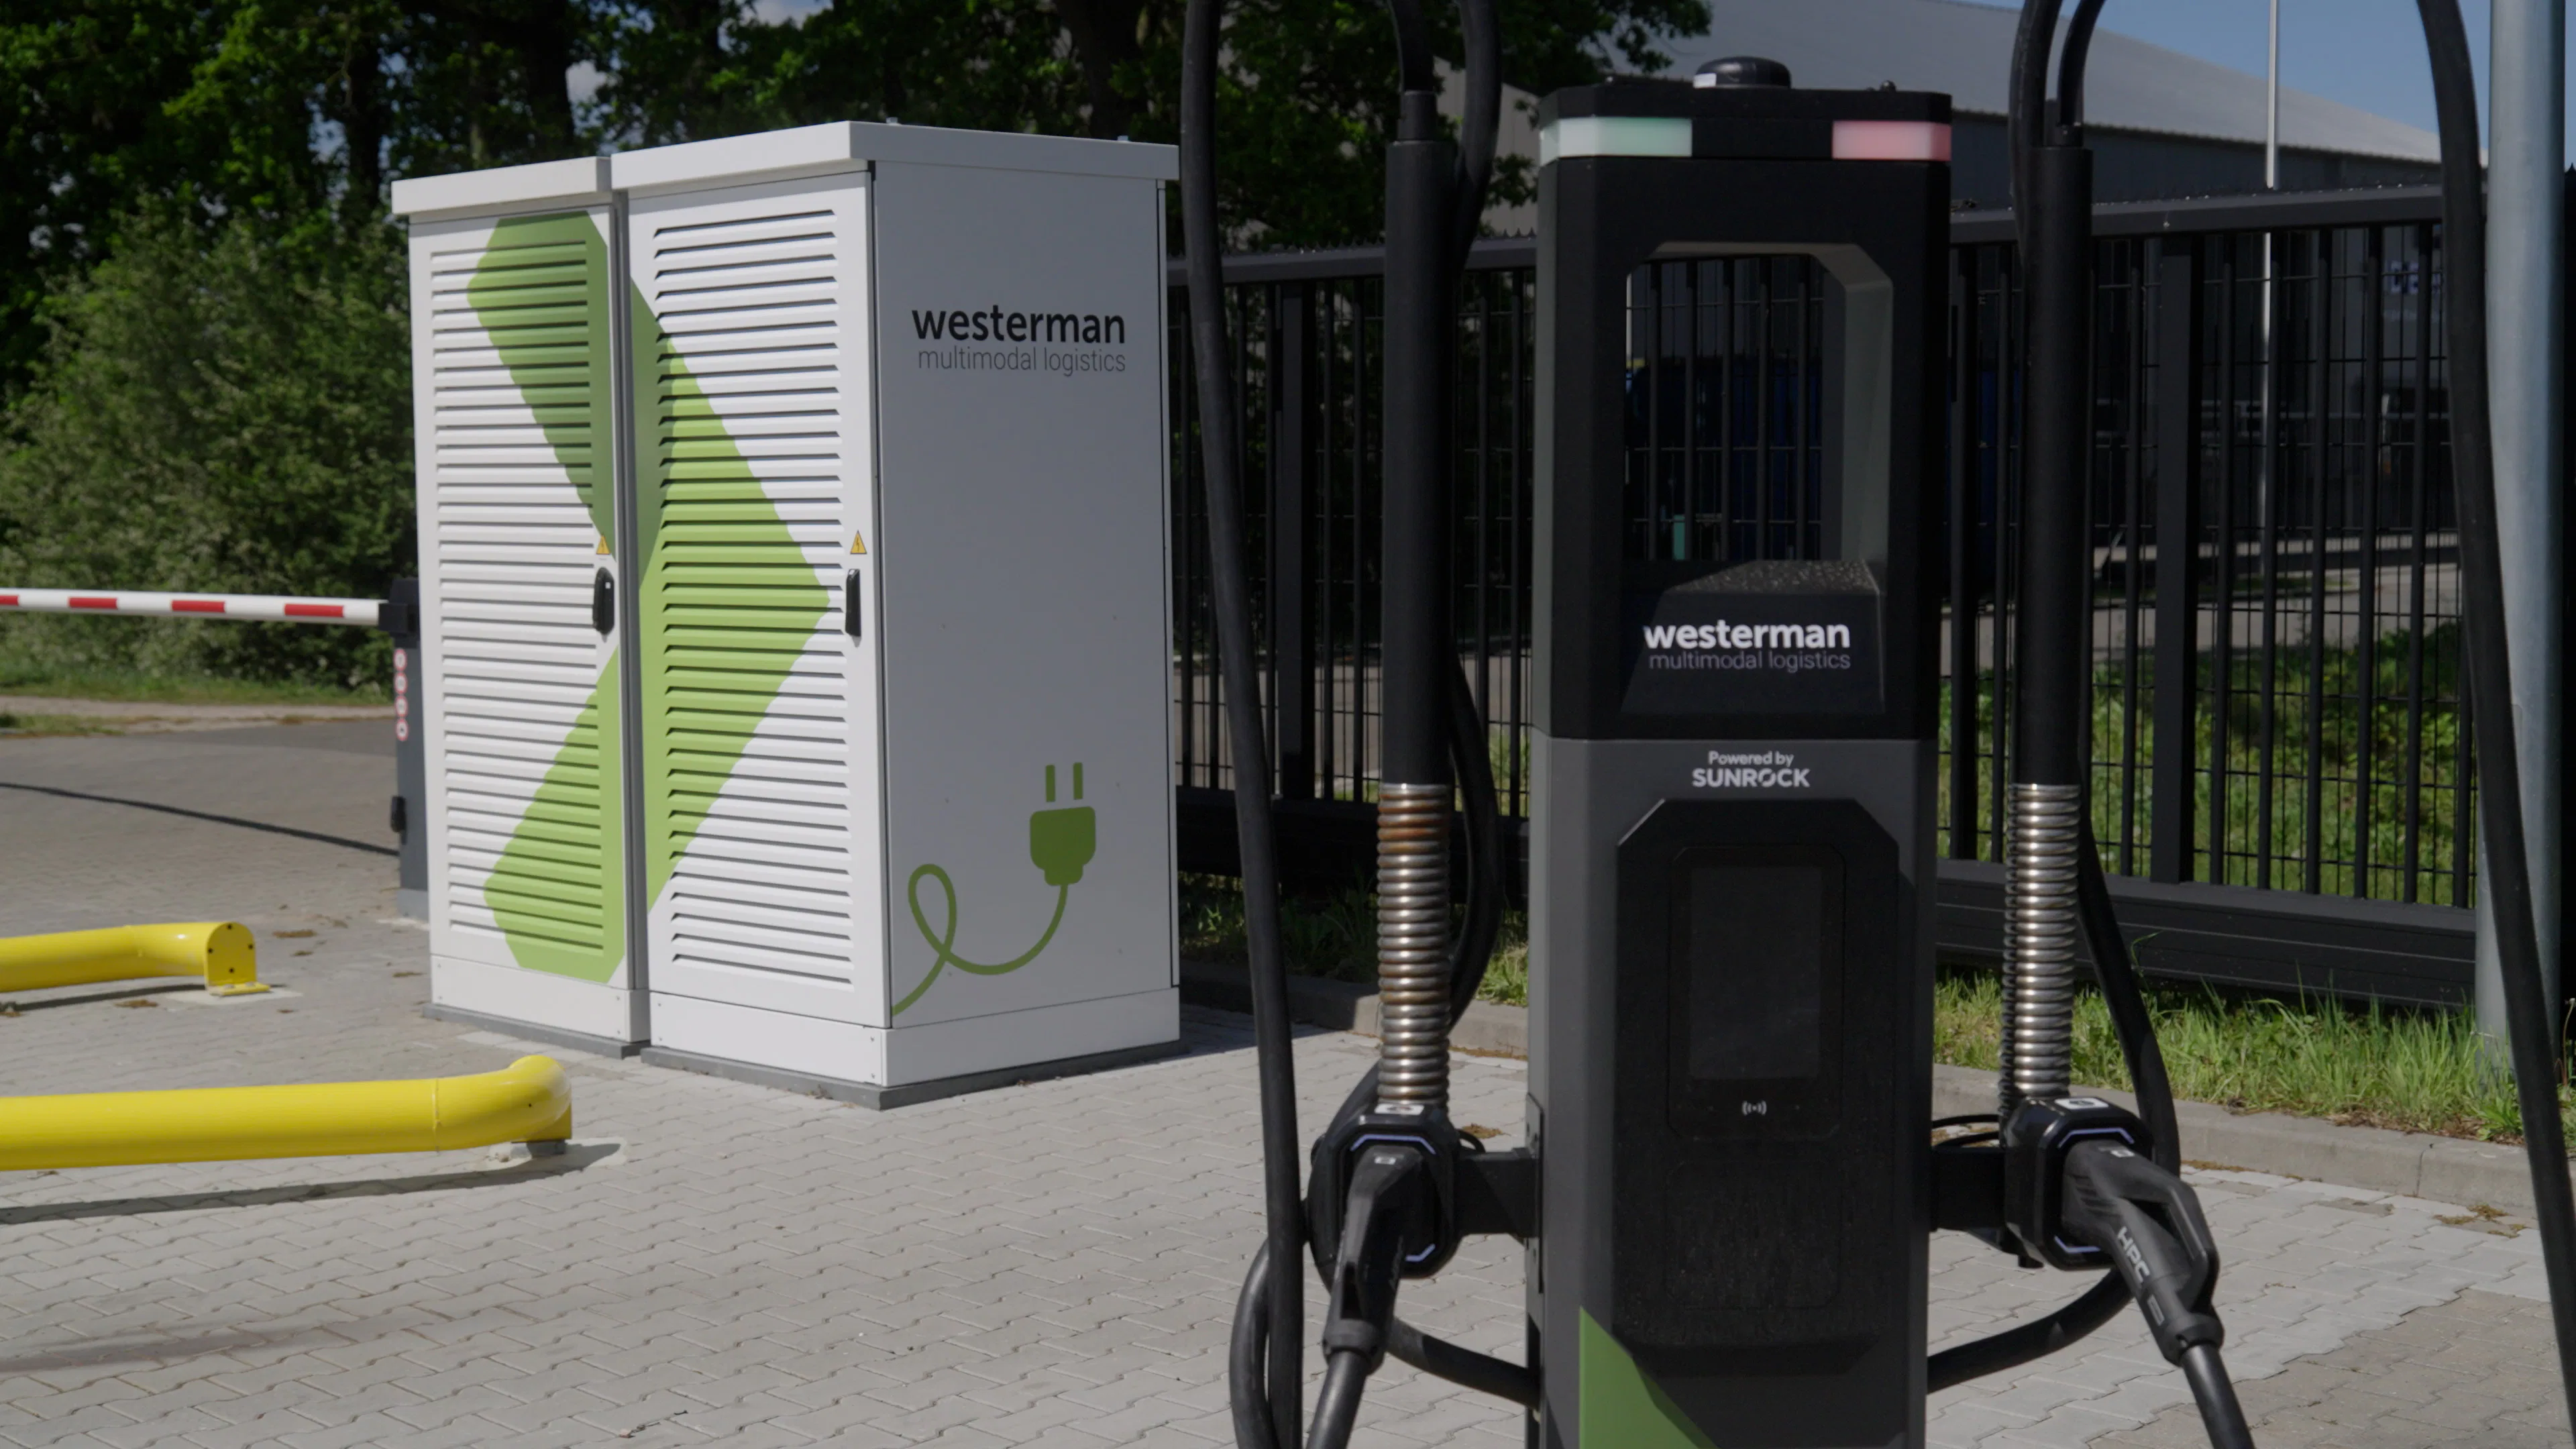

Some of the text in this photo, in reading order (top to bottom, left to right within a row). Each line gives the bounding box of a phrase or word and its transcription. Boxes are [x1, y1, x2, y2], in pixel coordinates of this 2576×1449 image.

[911, 305, 1126, 343] westerman
[918, 345, 1126, 378] multimodal logistics
[1643, 619, 1851, 649] westerman
[1648, 651, 1851, 674] multimodal logistics
[1708, 750, 1794, 767] Powered by
[1692, 767, 1811, 788] SUNROCK
[2117, 1226, 2151, 1283] HPC
